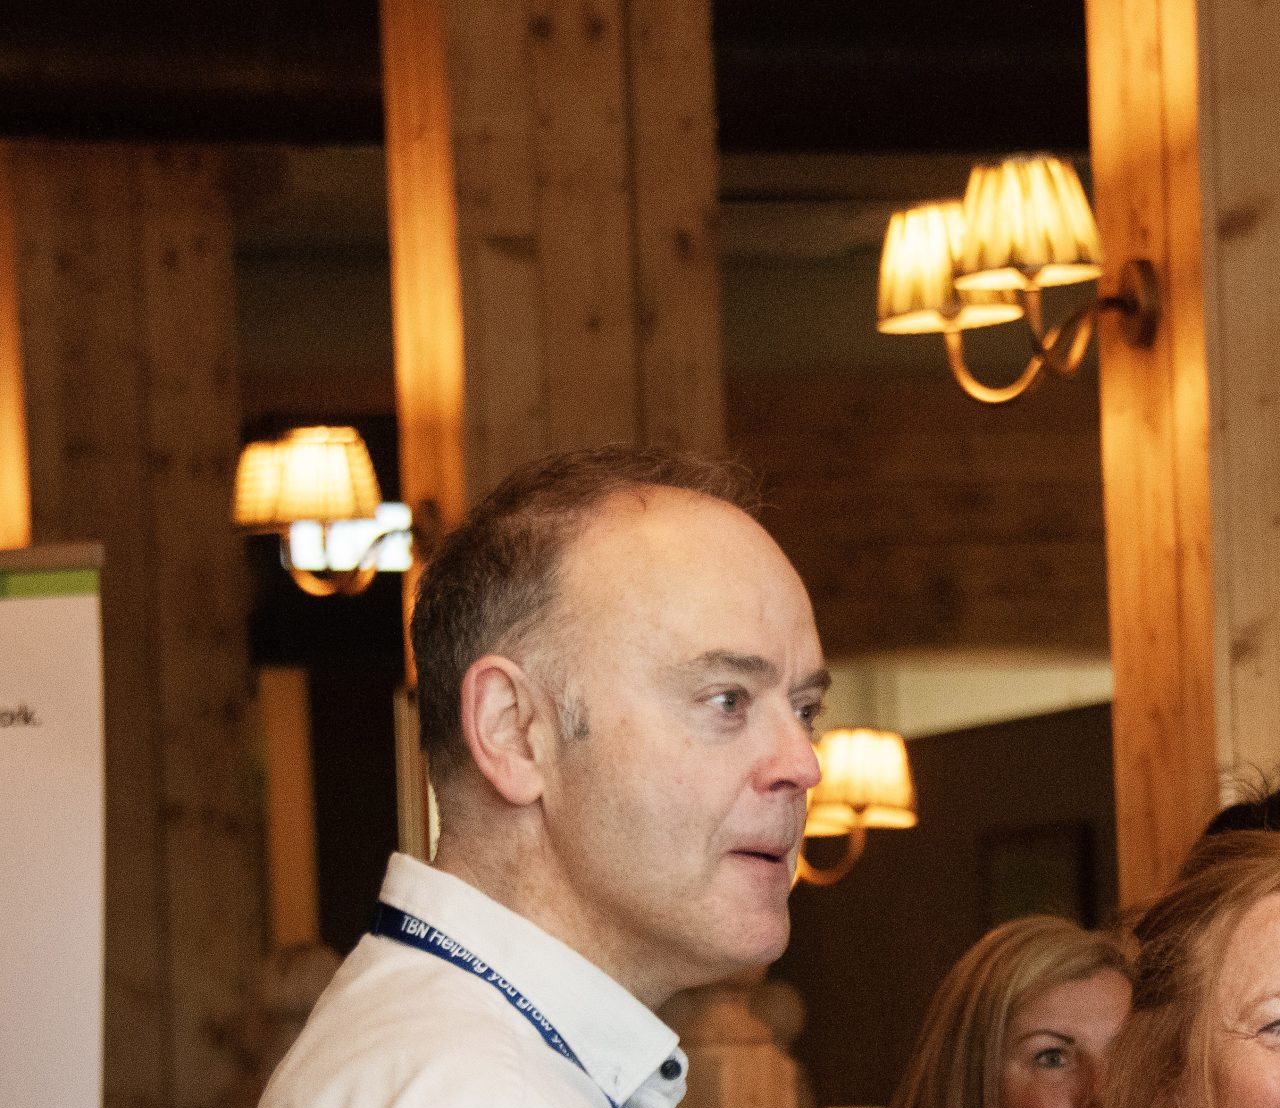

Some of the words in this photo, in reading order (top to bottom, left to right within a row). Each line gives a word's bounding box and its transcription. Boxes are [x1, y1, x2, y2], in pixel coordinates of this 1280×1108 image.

[401, 914, 430, 939] TBN
[429, 928, 488, 974] Helping
[487, 970, 518, 997] you
[515, 993, 553, 1032] grow
